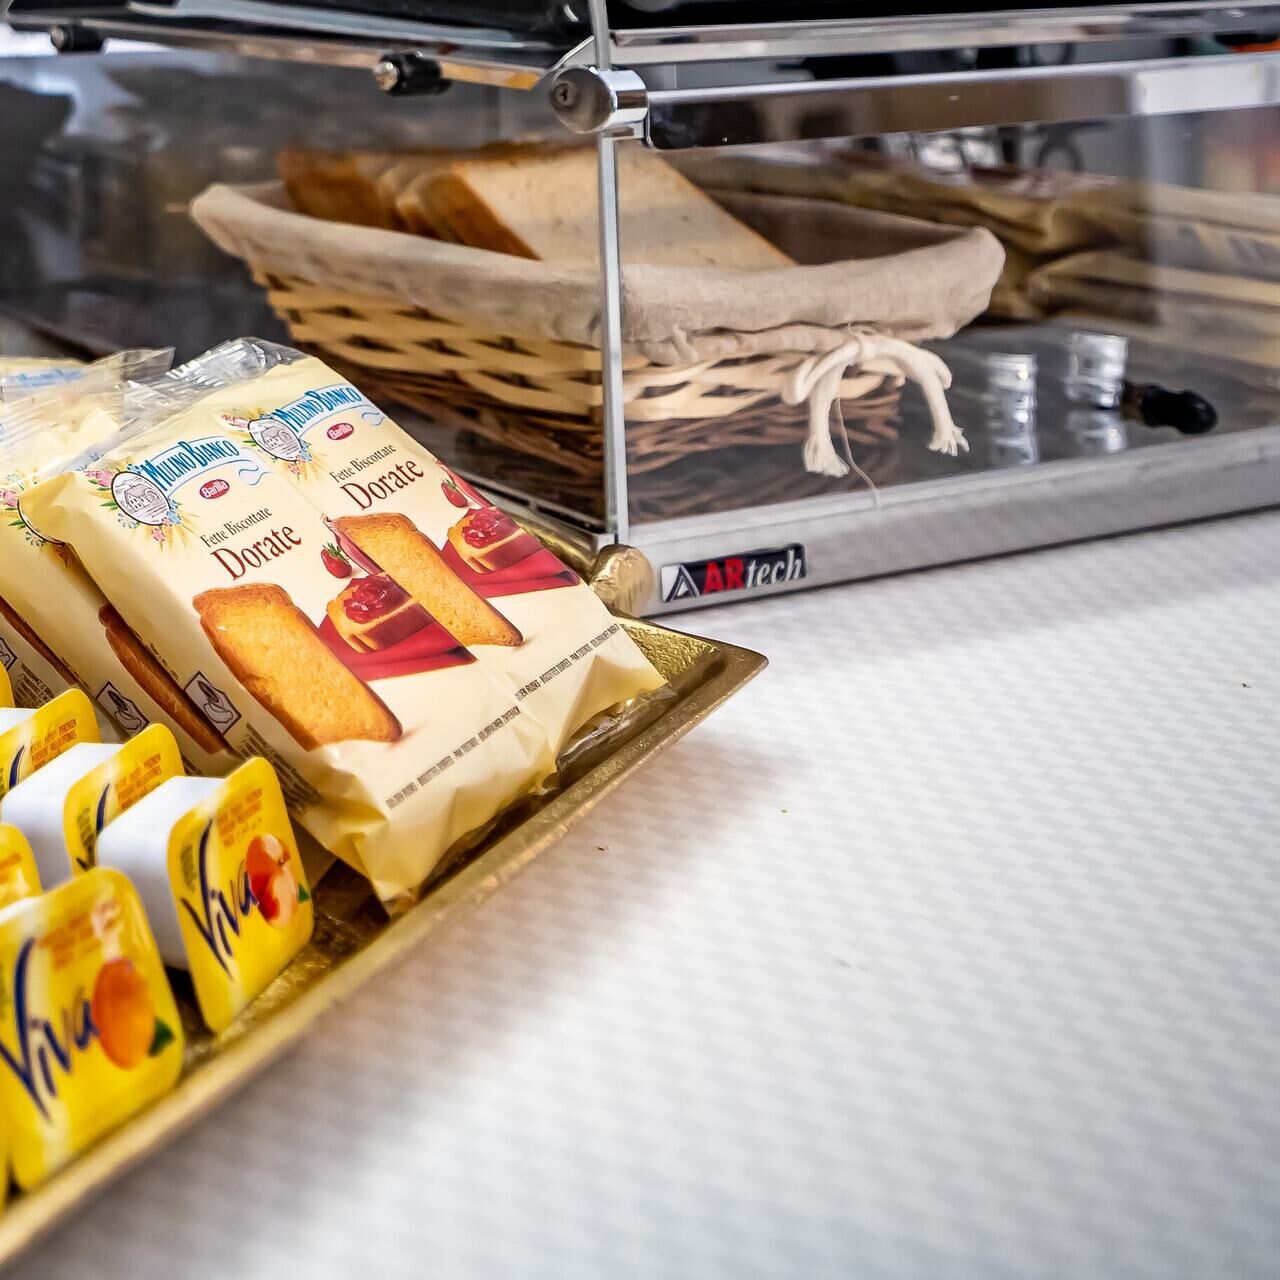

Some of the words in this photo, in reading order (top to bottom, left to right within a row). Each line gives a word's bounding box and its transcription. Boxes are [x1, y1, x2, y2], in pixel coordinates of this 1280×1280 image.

[270, 395, 323, 433] MULINO
[305, 386, 362, 414] BIANCO
[142, 446, 195, 492] MULINO
[179, 440, 240, 468] BIANCO
[329, 462, 354, 484] Fette
[351, 442, 397, 474] Biscottate
[339, 458, 425, 511] Dorate
[201, 480, 229, 499] Barilla
[200, 527, 227, 549] Fette
[224, 506, 273, 536] Biscottate
[209, 522, 303, 581] Dorate
[703, 549, 803, 594] ARtech
